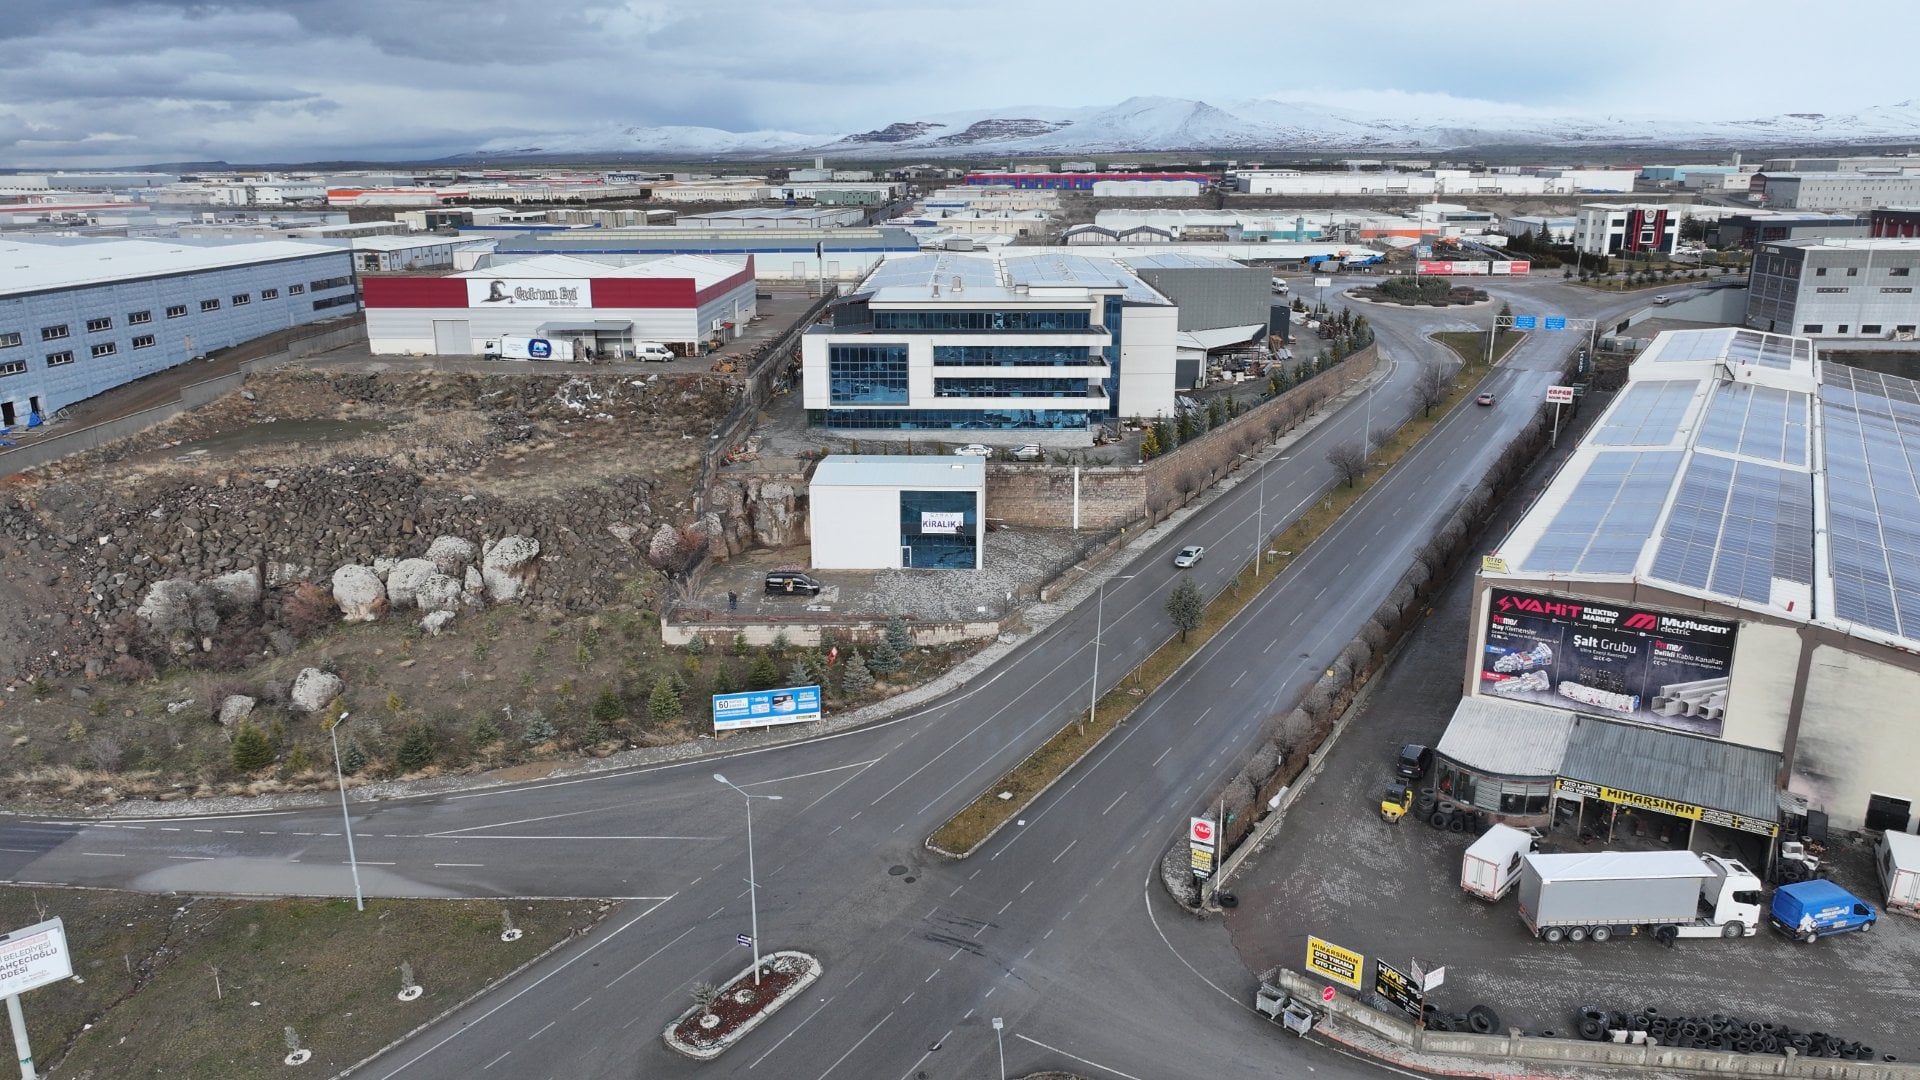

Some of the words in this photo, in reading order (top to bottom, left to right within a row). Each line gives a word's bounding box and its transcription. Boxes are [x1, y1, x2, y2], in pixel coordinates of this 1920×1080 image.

[922, 518, 957, 528] KİRALIK
[1583, 607, 1620, 618] ELEKTRO
[1582, 614, 1617, 625] MARKET
[1492, 623, 1504, 632] Ray
[1660, 626, 1691, 636] electric
[1661, 617, 1728, 634] Mutlusan
[1573, 634, 1599, 648] Şalt
[1600, 639, 1637, 654] Grubu
[3, 940, 52, 962] BELEDİYESİ
[1314, 950, 1328, 960] OTO
[1315, 959, 1328, 968] OTO
[0, 964, 28, 981] DDESİ
